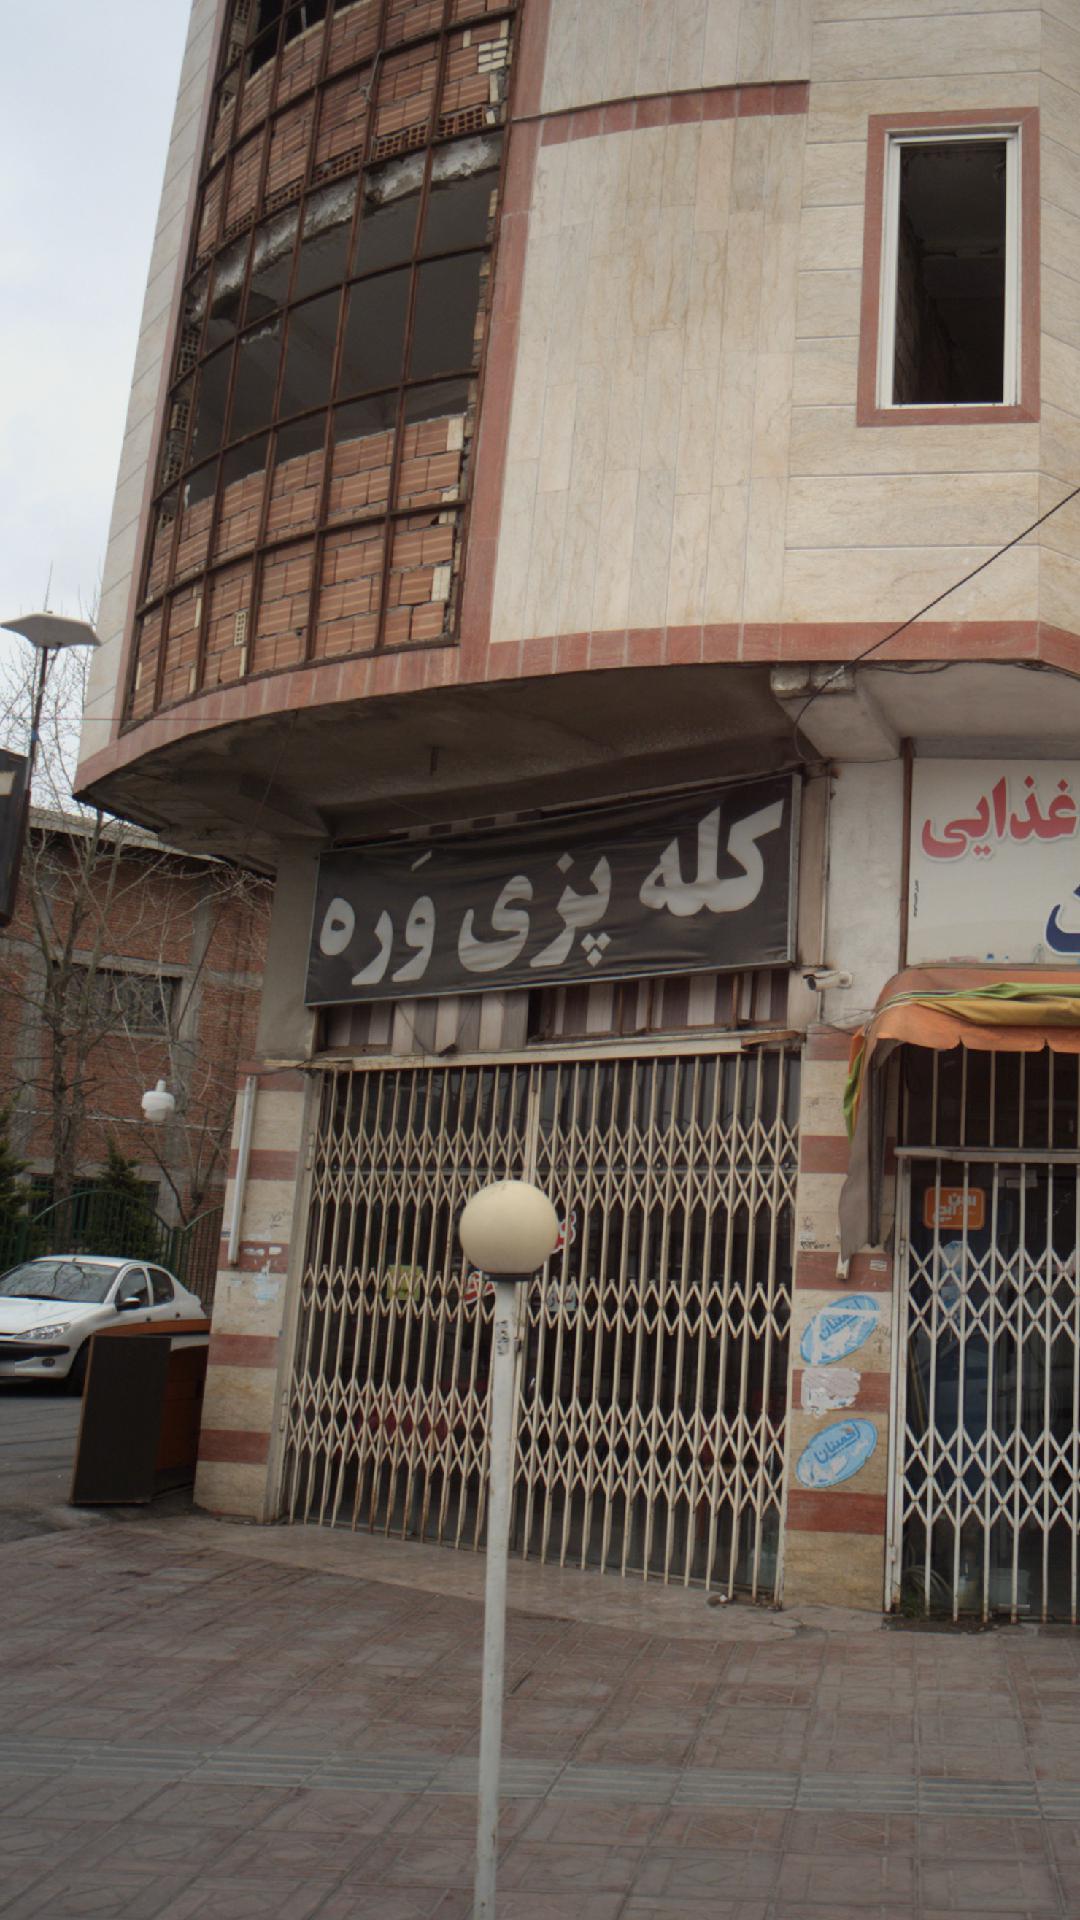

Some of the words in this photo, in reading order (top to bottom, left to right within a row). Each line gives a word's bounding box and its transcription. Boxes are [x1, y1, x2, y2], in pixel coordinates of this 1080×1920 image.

[638, 798, 785, 918] کله
[921, 775, 1077, 859] غذایی
[456, 851, 613, 973] پزی
